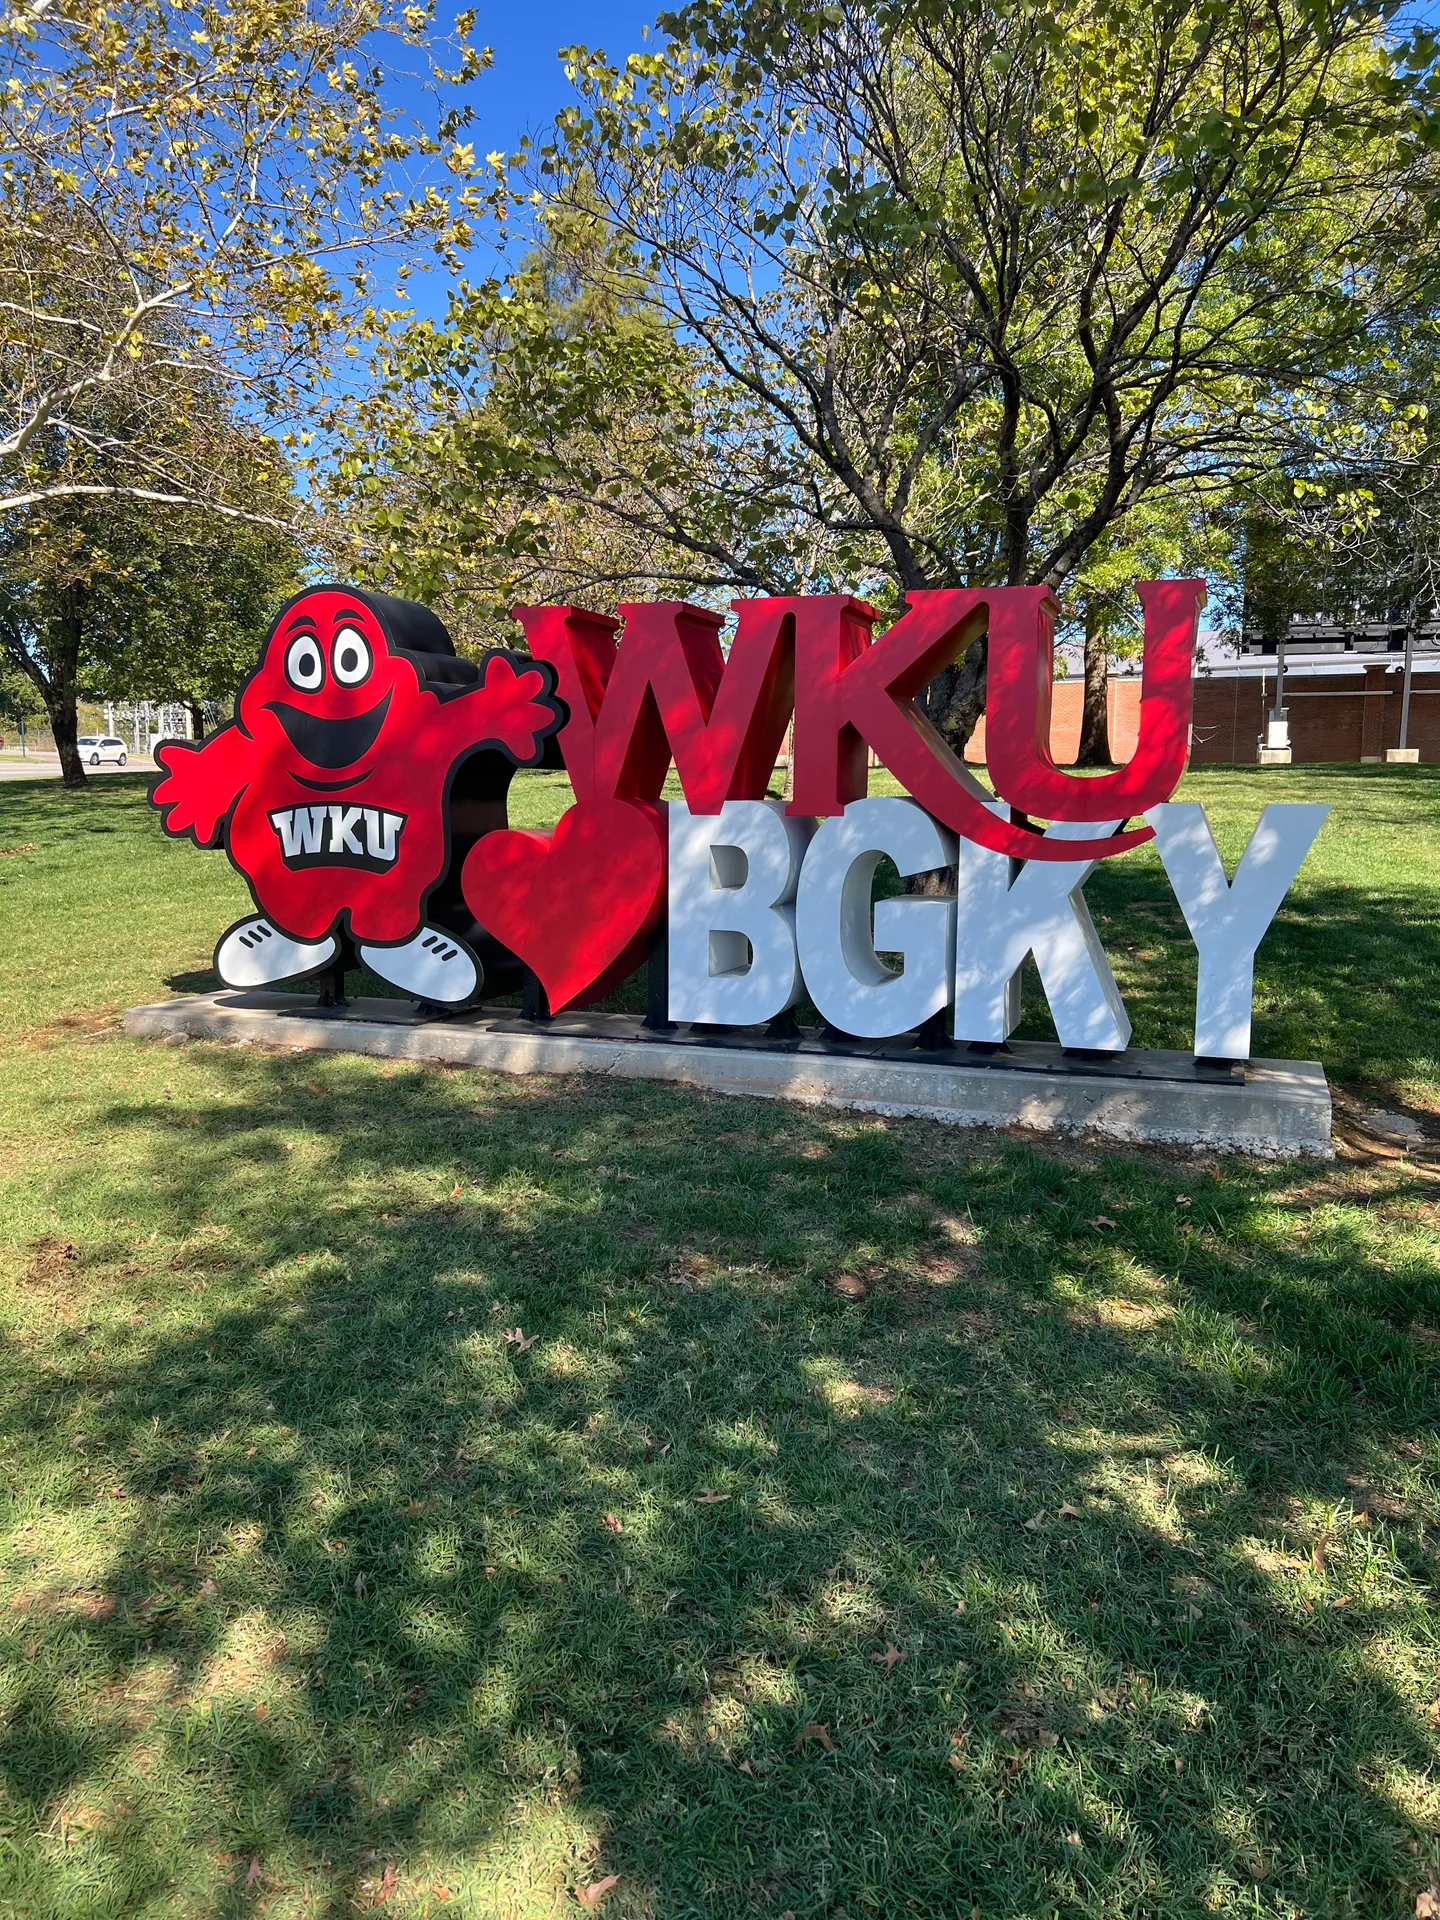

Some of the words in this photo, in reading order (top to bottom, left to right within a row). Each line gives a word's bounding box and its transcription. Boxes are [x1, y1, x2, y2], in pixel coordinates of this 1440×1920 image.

[271, 805, 403, 861] WKU
[514, 579, 1206, 860] WKU
[667, 799, 1331, 1059] BGKY
